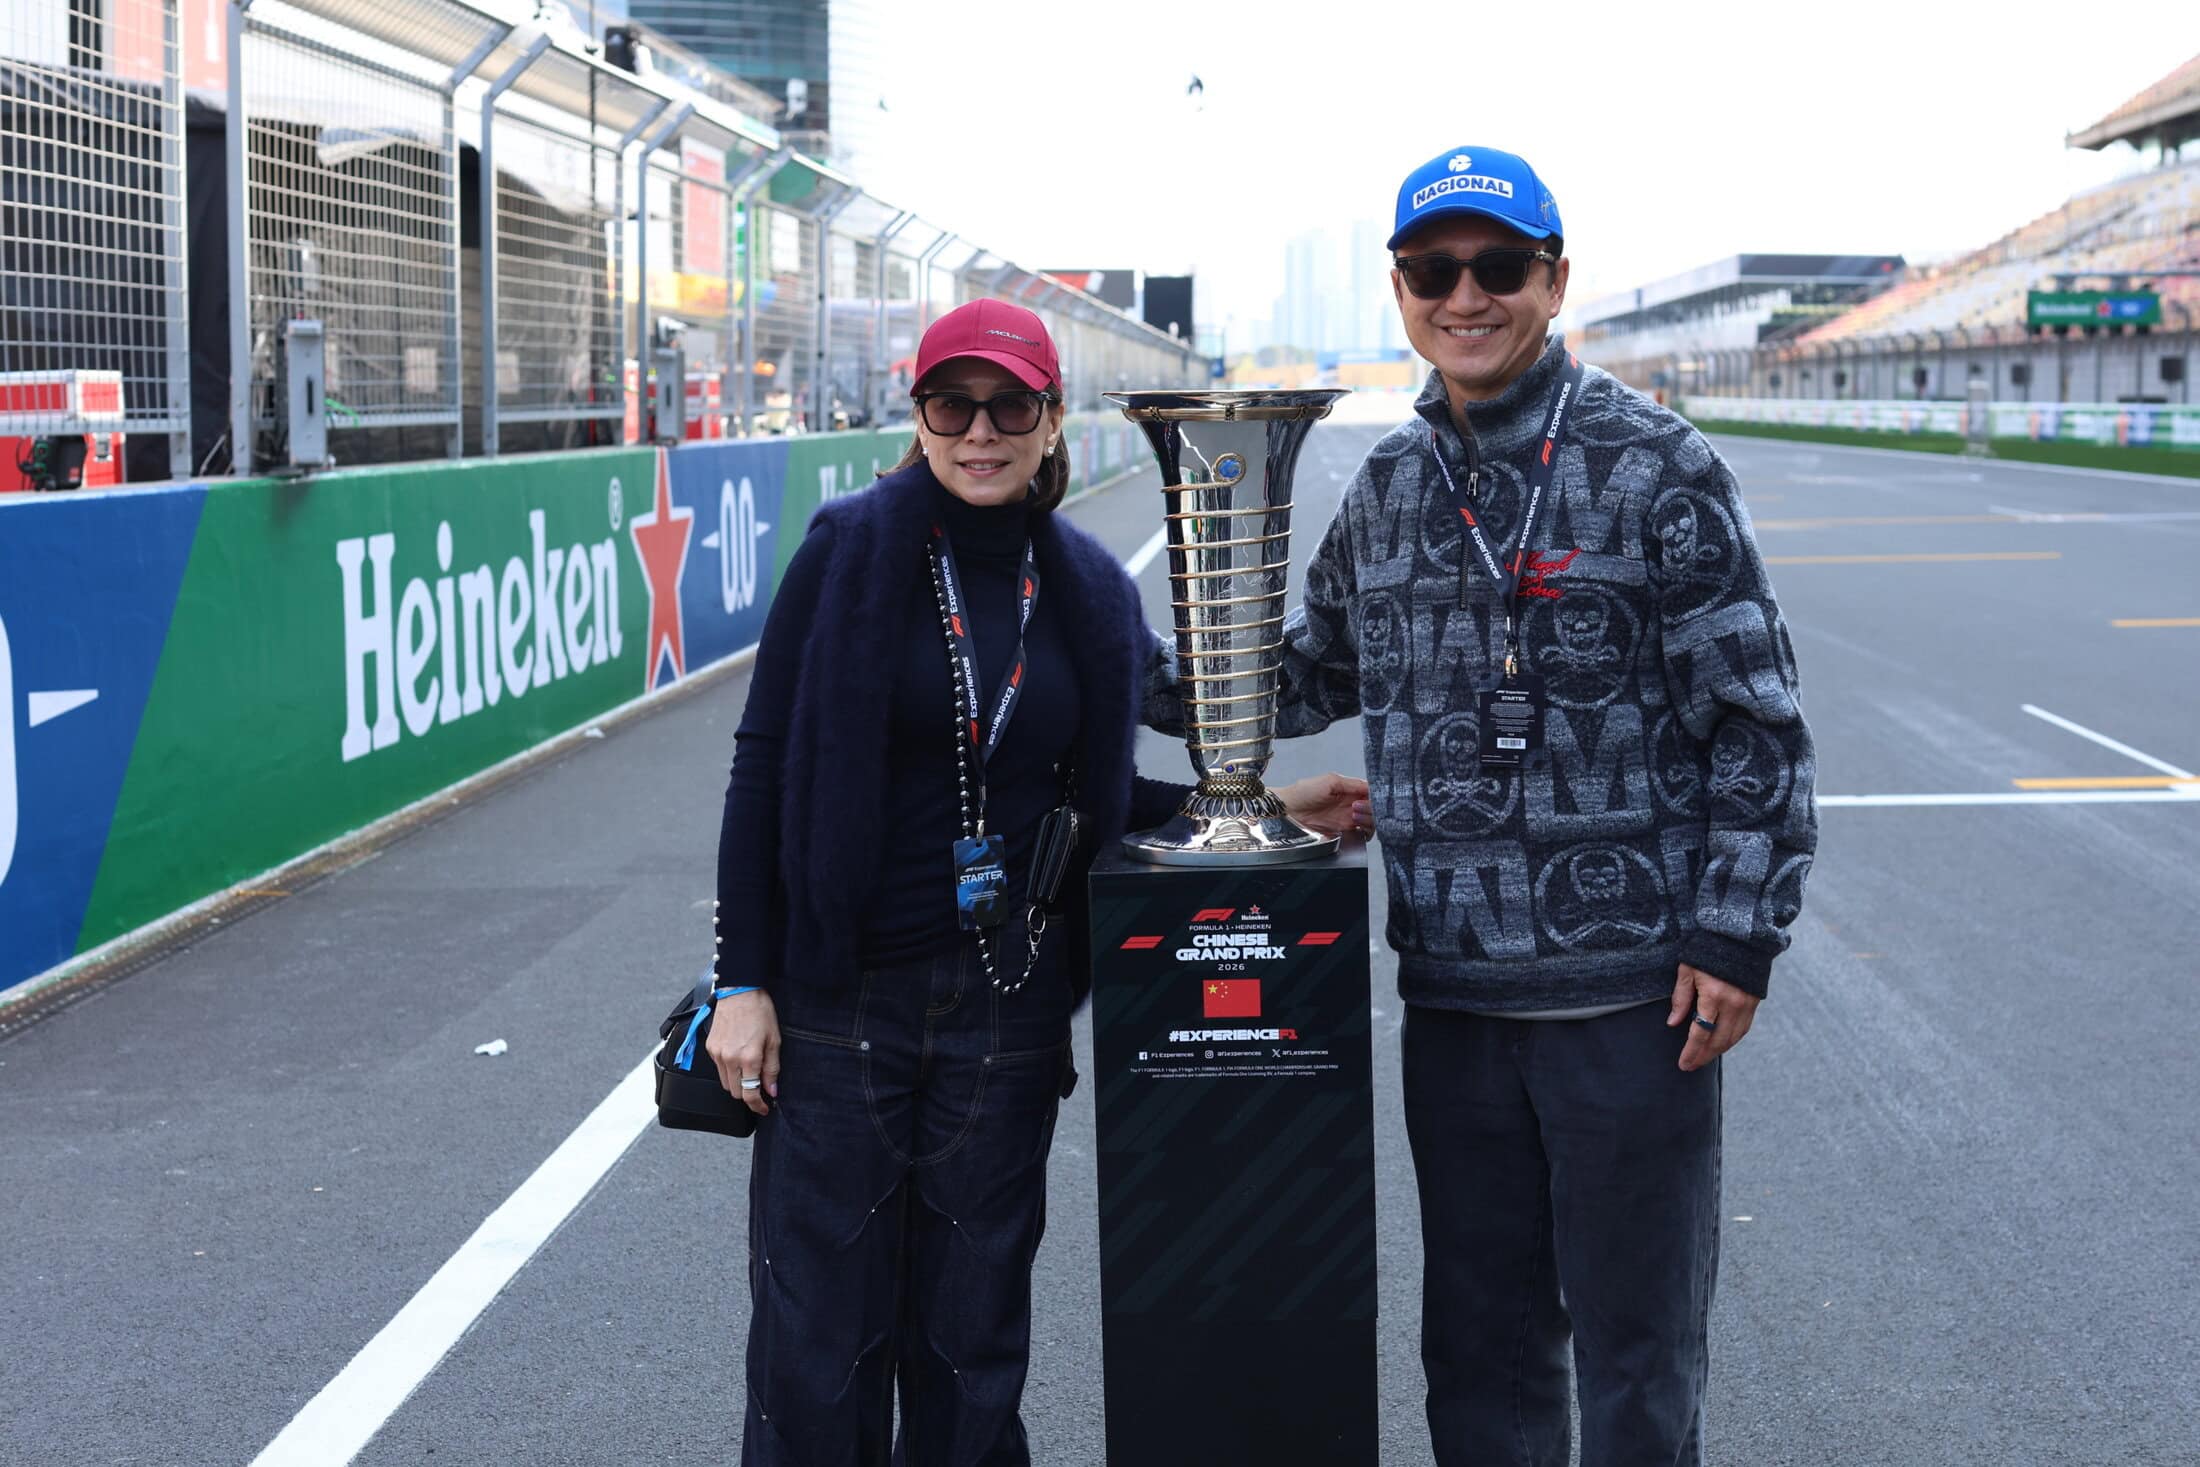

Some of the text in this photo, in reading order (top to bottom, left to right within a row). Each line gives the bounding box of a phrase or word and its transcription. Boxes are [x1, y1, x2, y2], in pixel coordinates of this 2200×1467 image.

[1416, 177, 1510, 206] NACIONAL
[985, 329, 1041, 347] McLaren
[1547, 381, 1572, 439] Experiences
[1518, 485, 1542, 549] Experiences
[941, 555, 959, 614] Experiences
[336, 508, 623, 763] Heineken
[962, 656, 979, 719] Experiences
[988, 687, 1016, 746] Experiences
[960, 869, 1003, 885] STARTER
[1176, 946, 1286, 961] GRAND PRIX
[1192, 933, 1268, 947] CHINESE
[1217, 963, 1245, 971] 2026
[1169, 1028, 1298, 1042] #EXPERIENCEF1
